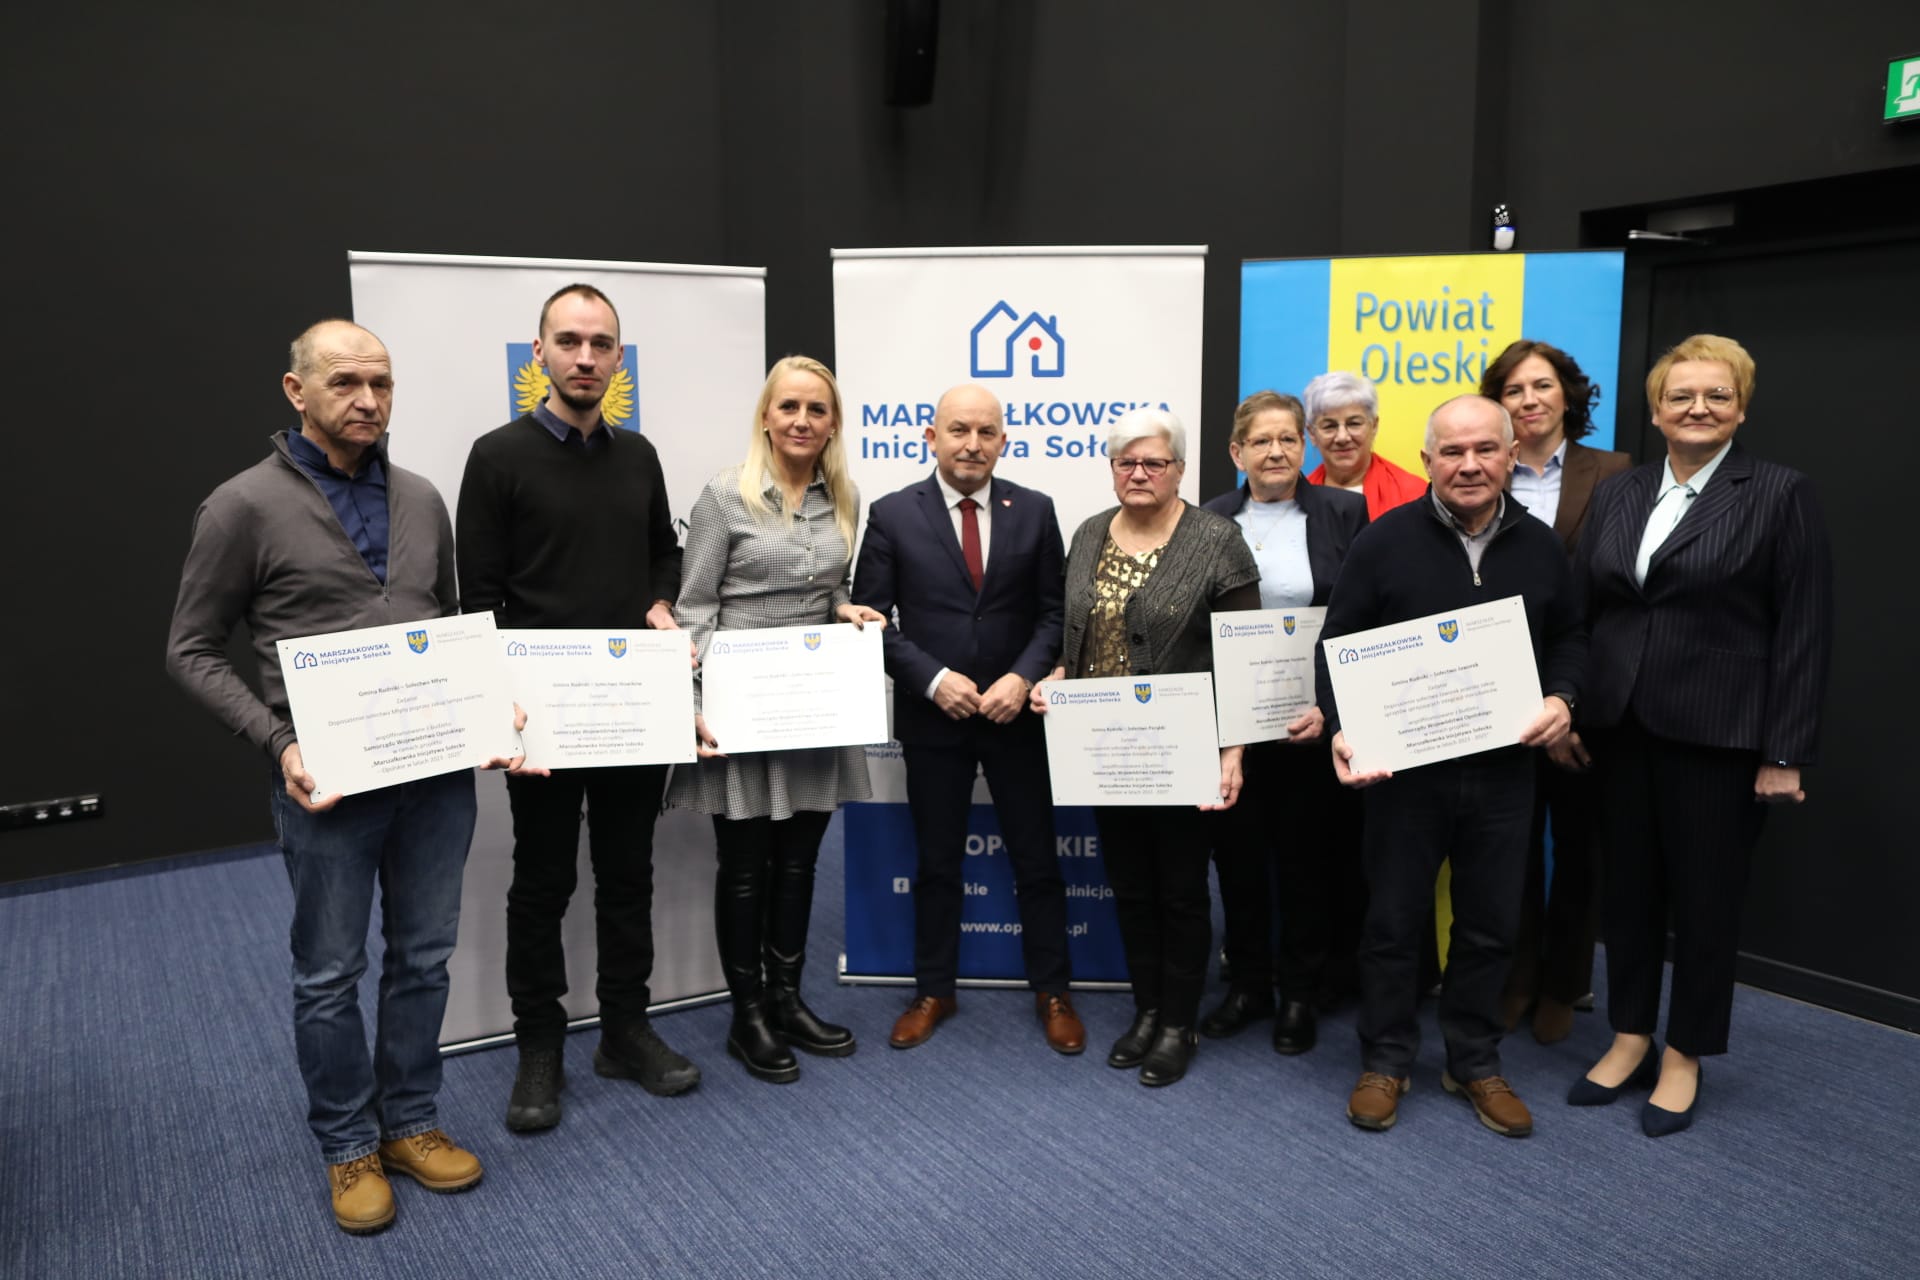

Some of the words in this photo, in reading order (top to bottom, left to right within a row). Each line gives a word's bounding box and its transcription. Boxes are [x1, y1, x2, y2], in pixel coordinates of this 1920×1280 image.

[1355, 285, 1495, 332] Powiat
[1361, 338, 1489, 384] Oleski
[862, 402, 1171, 427] MARŁKOWS
[319, 643, 390, 659] MARSZAŁKOWSKA
[1360, 634, 1422, 654] MARSZAŁKOWSKA
[1397, 640, 1424, 652] Sołecka
[321, 654, 361, 667] Inicjatywa
[363, 649, 392, 659] Sołecka
[965, 834, 1097, 858] OPKIE
[960, 922, 1088, 936] www.op.pl
